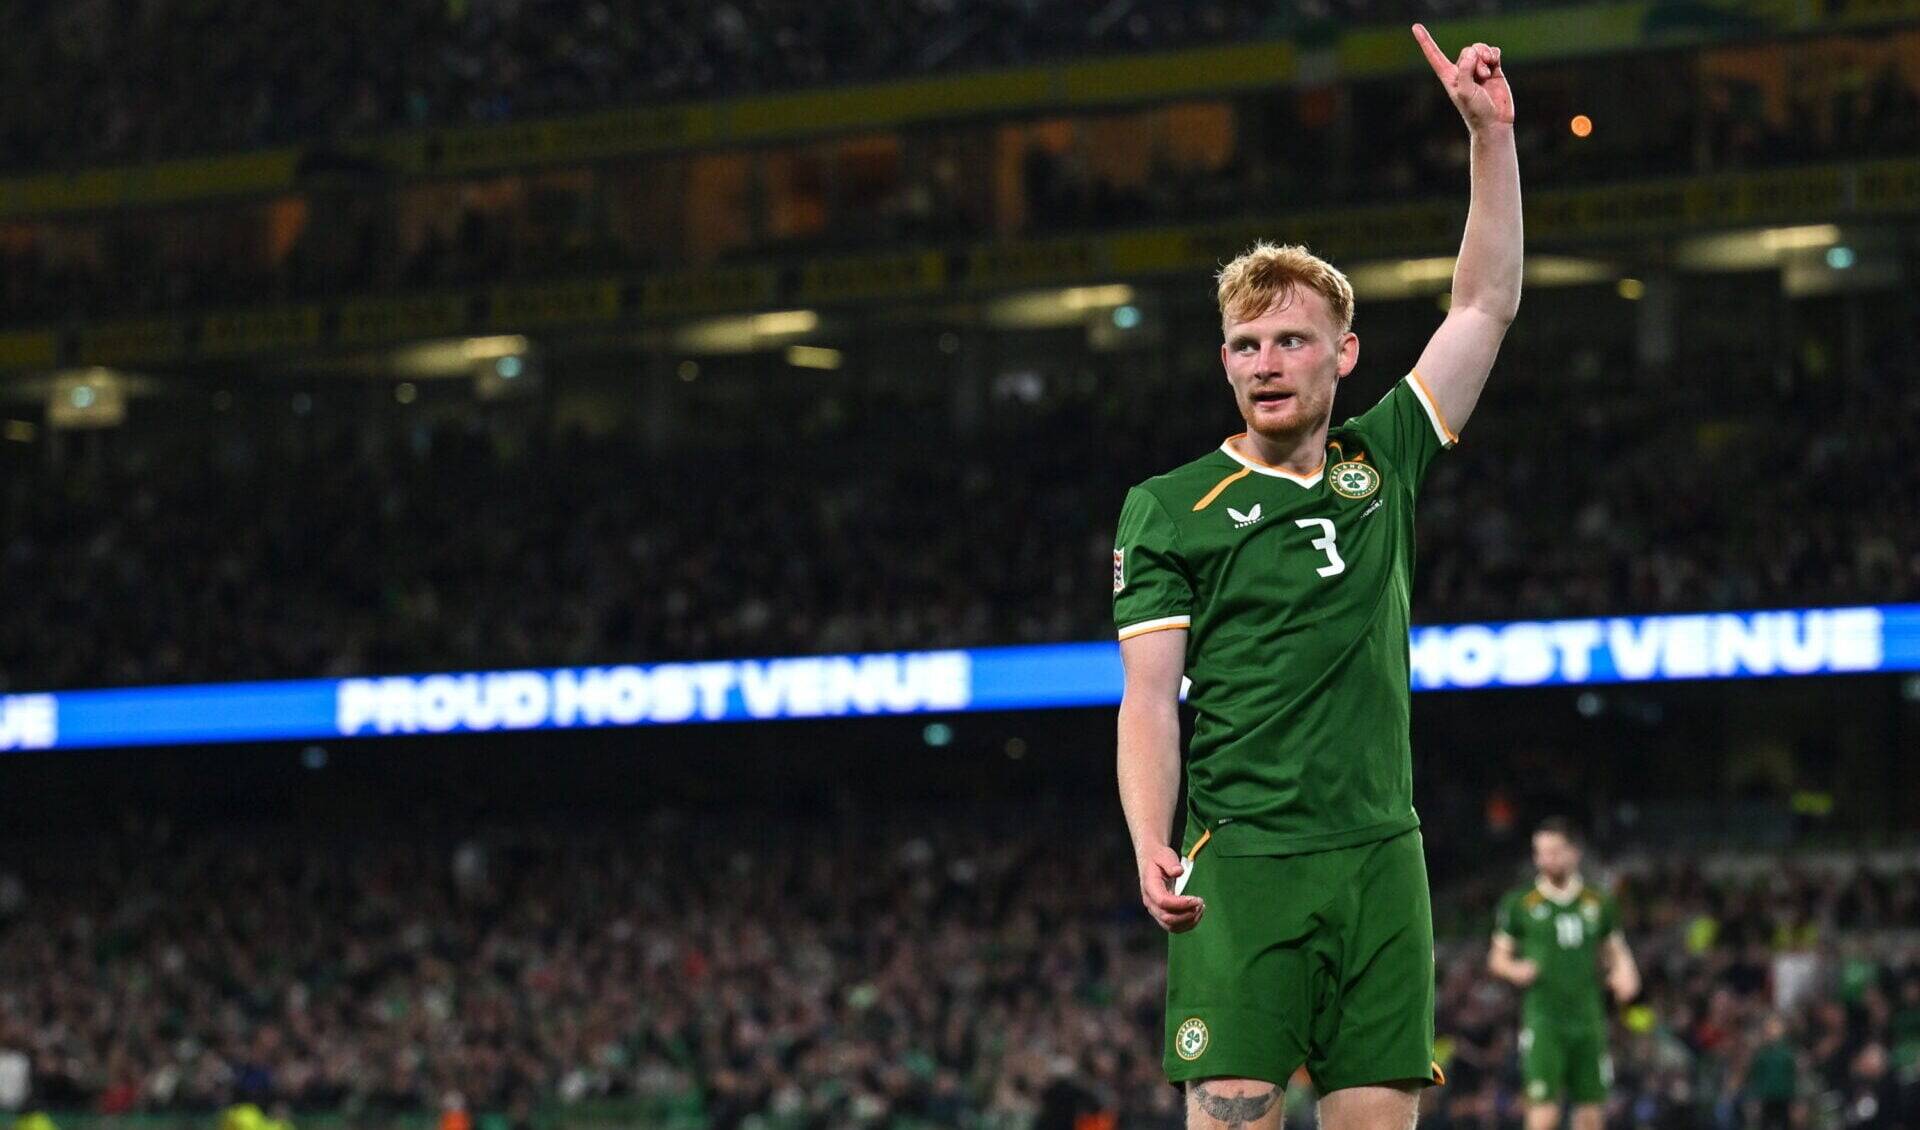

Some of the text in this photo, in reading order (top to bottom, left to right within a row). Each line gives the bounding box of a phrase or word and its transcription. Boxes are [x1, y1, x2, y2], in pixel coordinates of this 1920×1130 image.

[1295, 518, 1345, 577] 3
[1410, 607, 1884, 688] HOST VENUE
[337, 650, 972, 736] PROUD HOST VENUE
